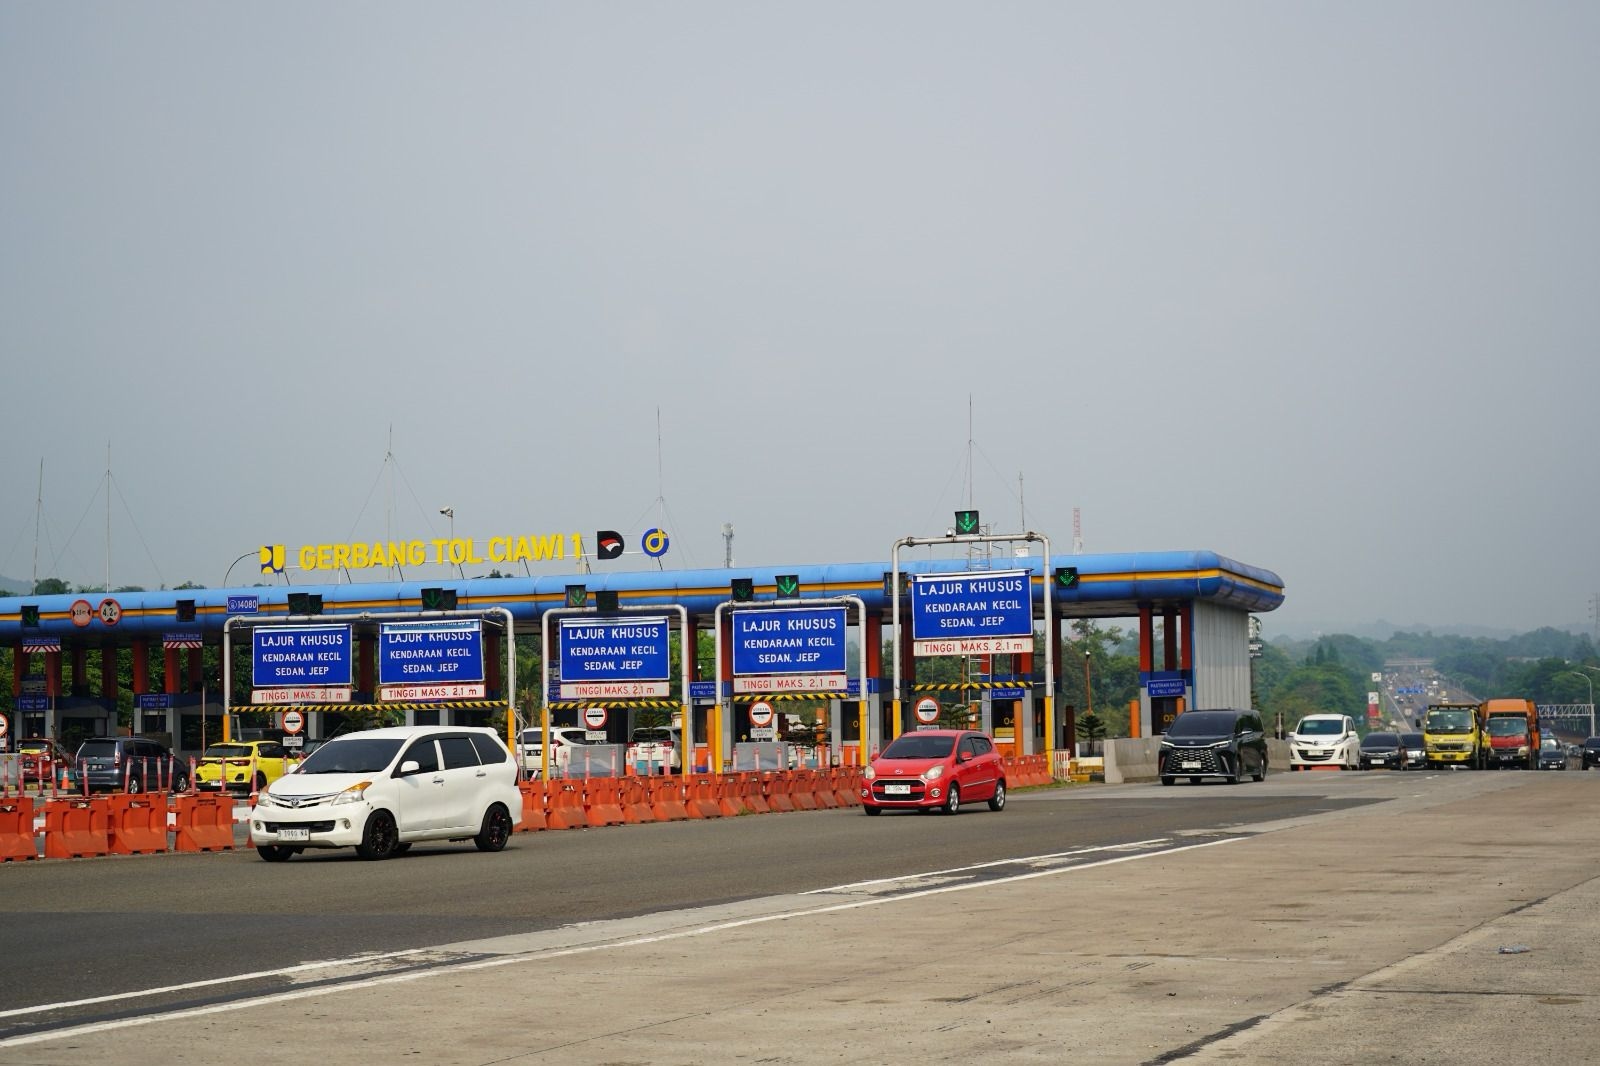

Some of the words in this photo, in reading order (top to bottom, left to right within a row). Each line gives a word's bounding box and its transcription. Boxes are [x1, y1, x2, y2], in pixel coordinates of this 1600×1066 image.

[300, 539, 426, 570] GERBANG
[432, 537, 484, 565] TOL
[488, 533, 565, 563] CIAWI
[571, 531, 582, 560] 1
[920, 583, 963, 596] LAJUR
[970, 580, 1023, 593] KHUSUS
[237, 600, 257, 609] 14080
[925, 601, 987, 613] KENDARAAN
[992, 600, 1022, 610] KECIL
[743, 620, 781, 632] LAJUR
[787, 618, 837, 631] KHUSUS
[979, 616, 1005, 627] JEEP
[389, 633, 422, 643] LAJUR
[428, 631, 473, 641] KHUSUS
[569, 628, 605, 640] LAJUR
[611, 627, 659, 639] KHUSUS
[261, 636, 295, 647] LAJUR
[300, 634, 343, 646] KHUSUS
[744, 638, 803, 649] KENDARAAN
[808, 637, 836, 647] KECIL
[570, 646, 626, 656] KENDARAAN
[631, 646, 658, 655] KECIL
[924, 643, 955, 653] TINGGI
[1013, 642, 1023, 650] m
[262, 652, 314, 663] KENDARAAN
[317, 652, 342, 661] KECIL
[390, 649, 443, 659] KENDARAAN
[446, 648, 472, 657] KECIL
[796, 652, 821, 662] JEEP
[308, 666, 329, 675] JEEP
[437, 663, 459, 672] JEEP
[620, 660, 643, 670] JEEP
[743, 680, 772, 689] TINGGI
[828, 679, 838, 687] m
[260, 691, 289, 700] TINGGI
[388, 689, 417, 698] TINGGI
[574, 686, 601, 695] TINGGI
